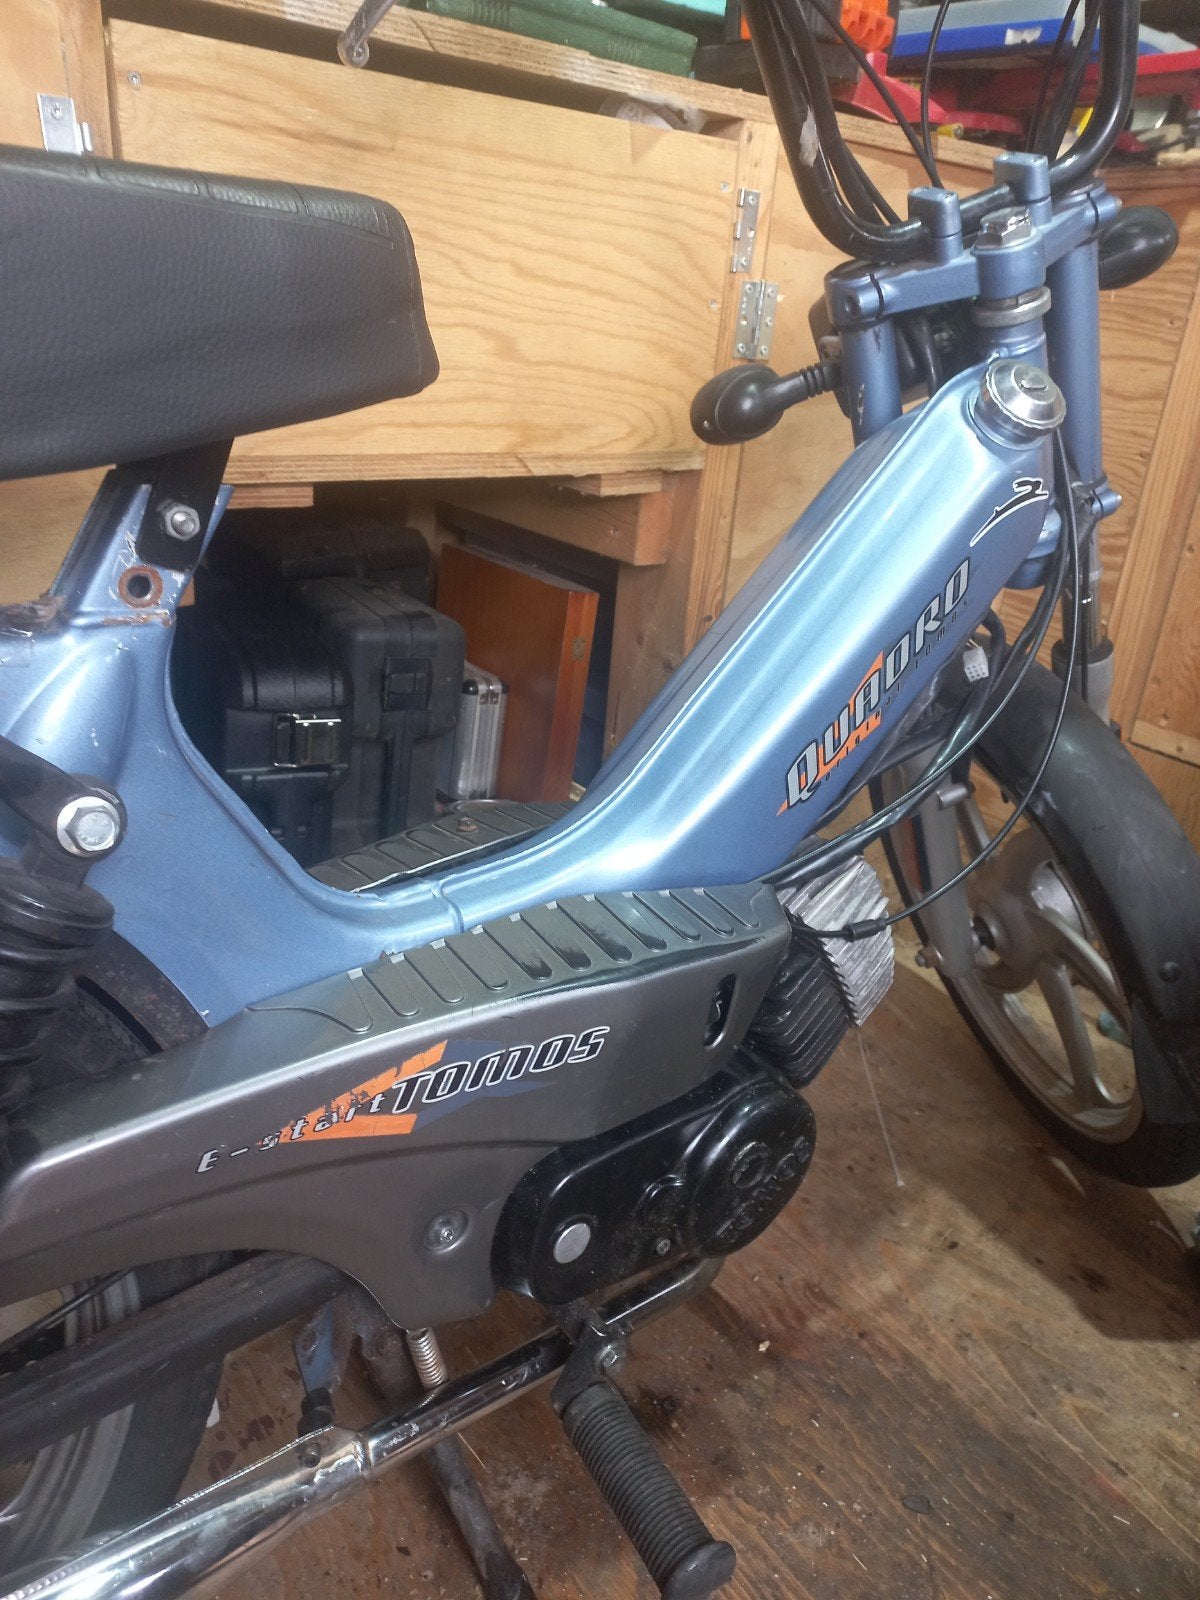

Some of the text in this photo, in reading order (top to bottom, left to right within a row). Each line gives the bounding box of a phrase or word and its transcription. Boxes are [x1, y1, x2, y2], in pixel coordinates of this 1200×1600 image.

[785, 556, 970, 809] QUADRO
[392, 1026, 610, 1113] TOMOS
[196, 1093, 386, 1173] E-start
